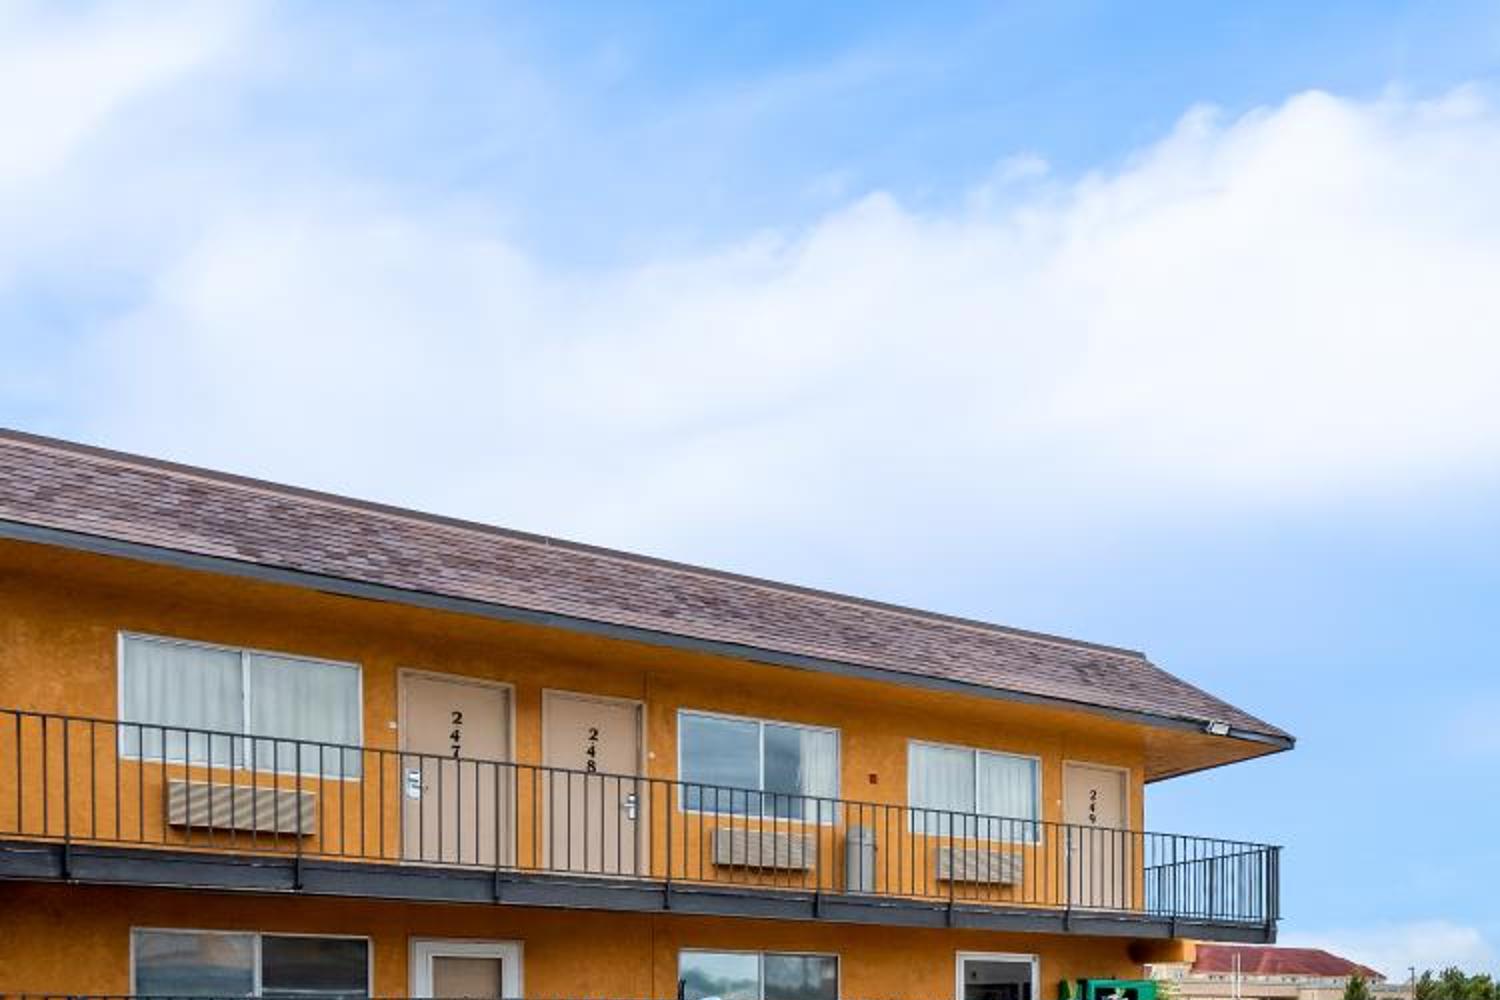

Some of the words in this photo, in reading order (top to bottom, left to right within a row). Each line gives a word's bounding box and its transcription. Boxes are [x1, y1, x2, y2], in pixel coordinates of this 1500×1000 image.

[449, 711, 464, 758] 247
[586, 727, 600, 773] 248
[1088, 789, 1098, 824] 249
